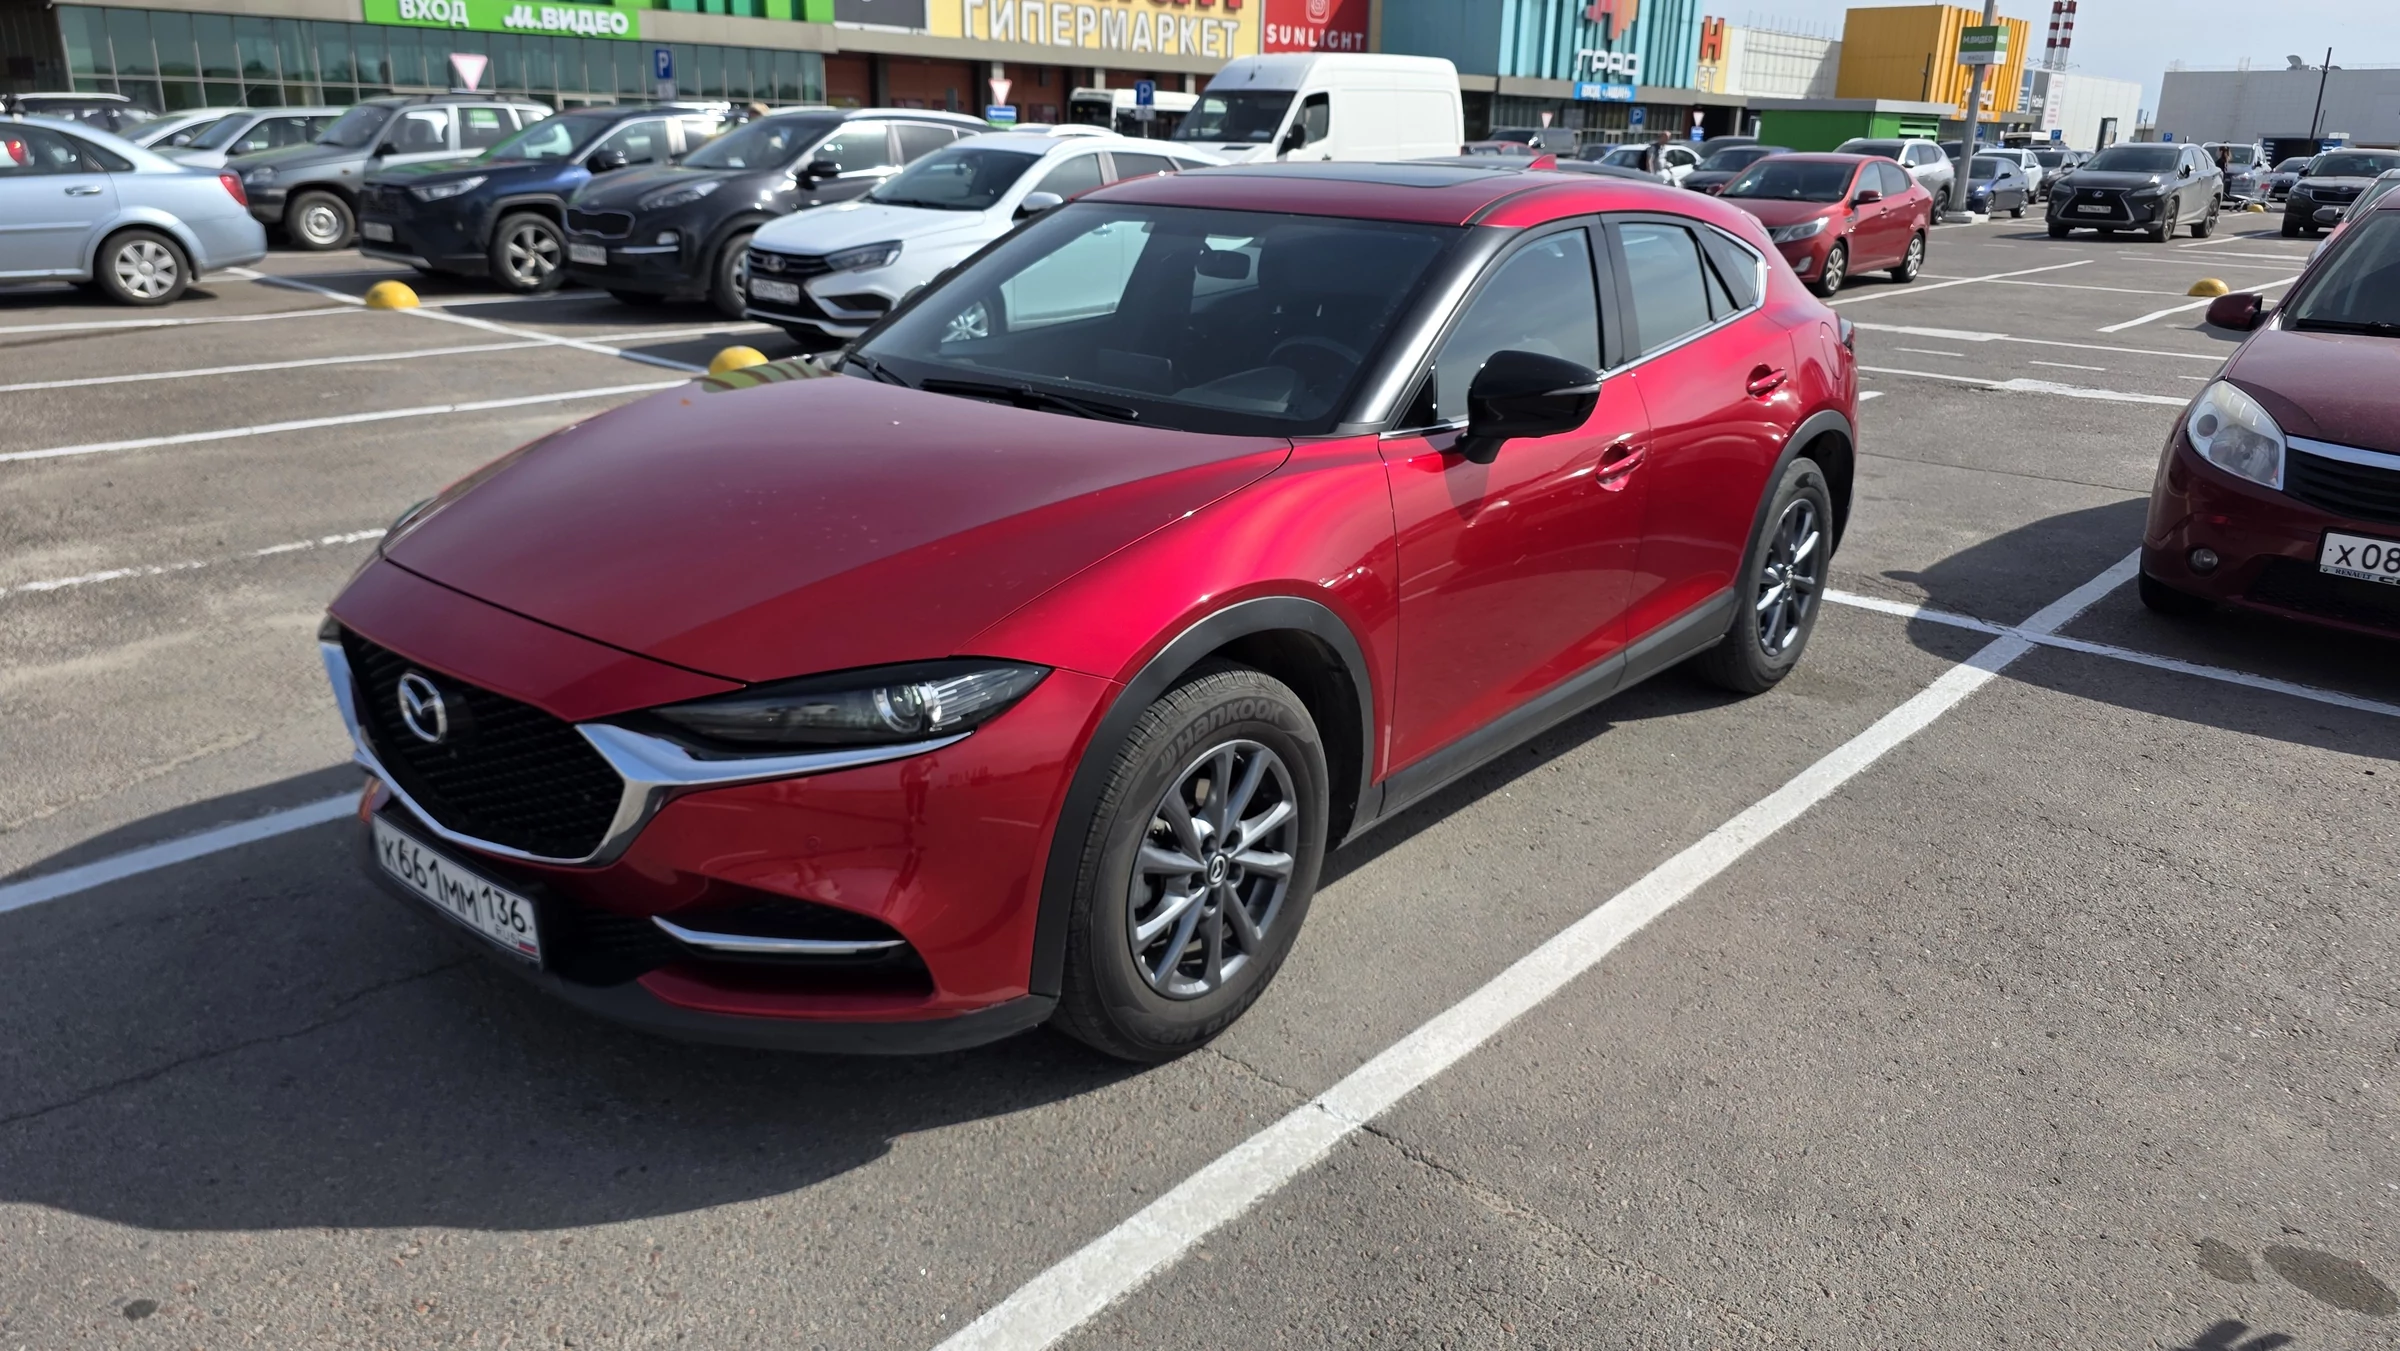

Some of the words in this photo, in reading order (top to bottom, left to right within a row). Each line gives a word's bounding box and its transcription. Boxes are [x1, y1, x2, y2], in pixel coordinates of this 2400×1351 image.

[400, 0, 470, 27] ВХОД
[963, 0, 1240, 58] ГИПЕРМАРКЕТ
[1266, 23, 1365, 50] SUNLIGHT
[1577, 49, 1639, 75] ГРАД
[2335, 568, 2373, 580] RENAULT
[495, 923, 519, 946] RUS
